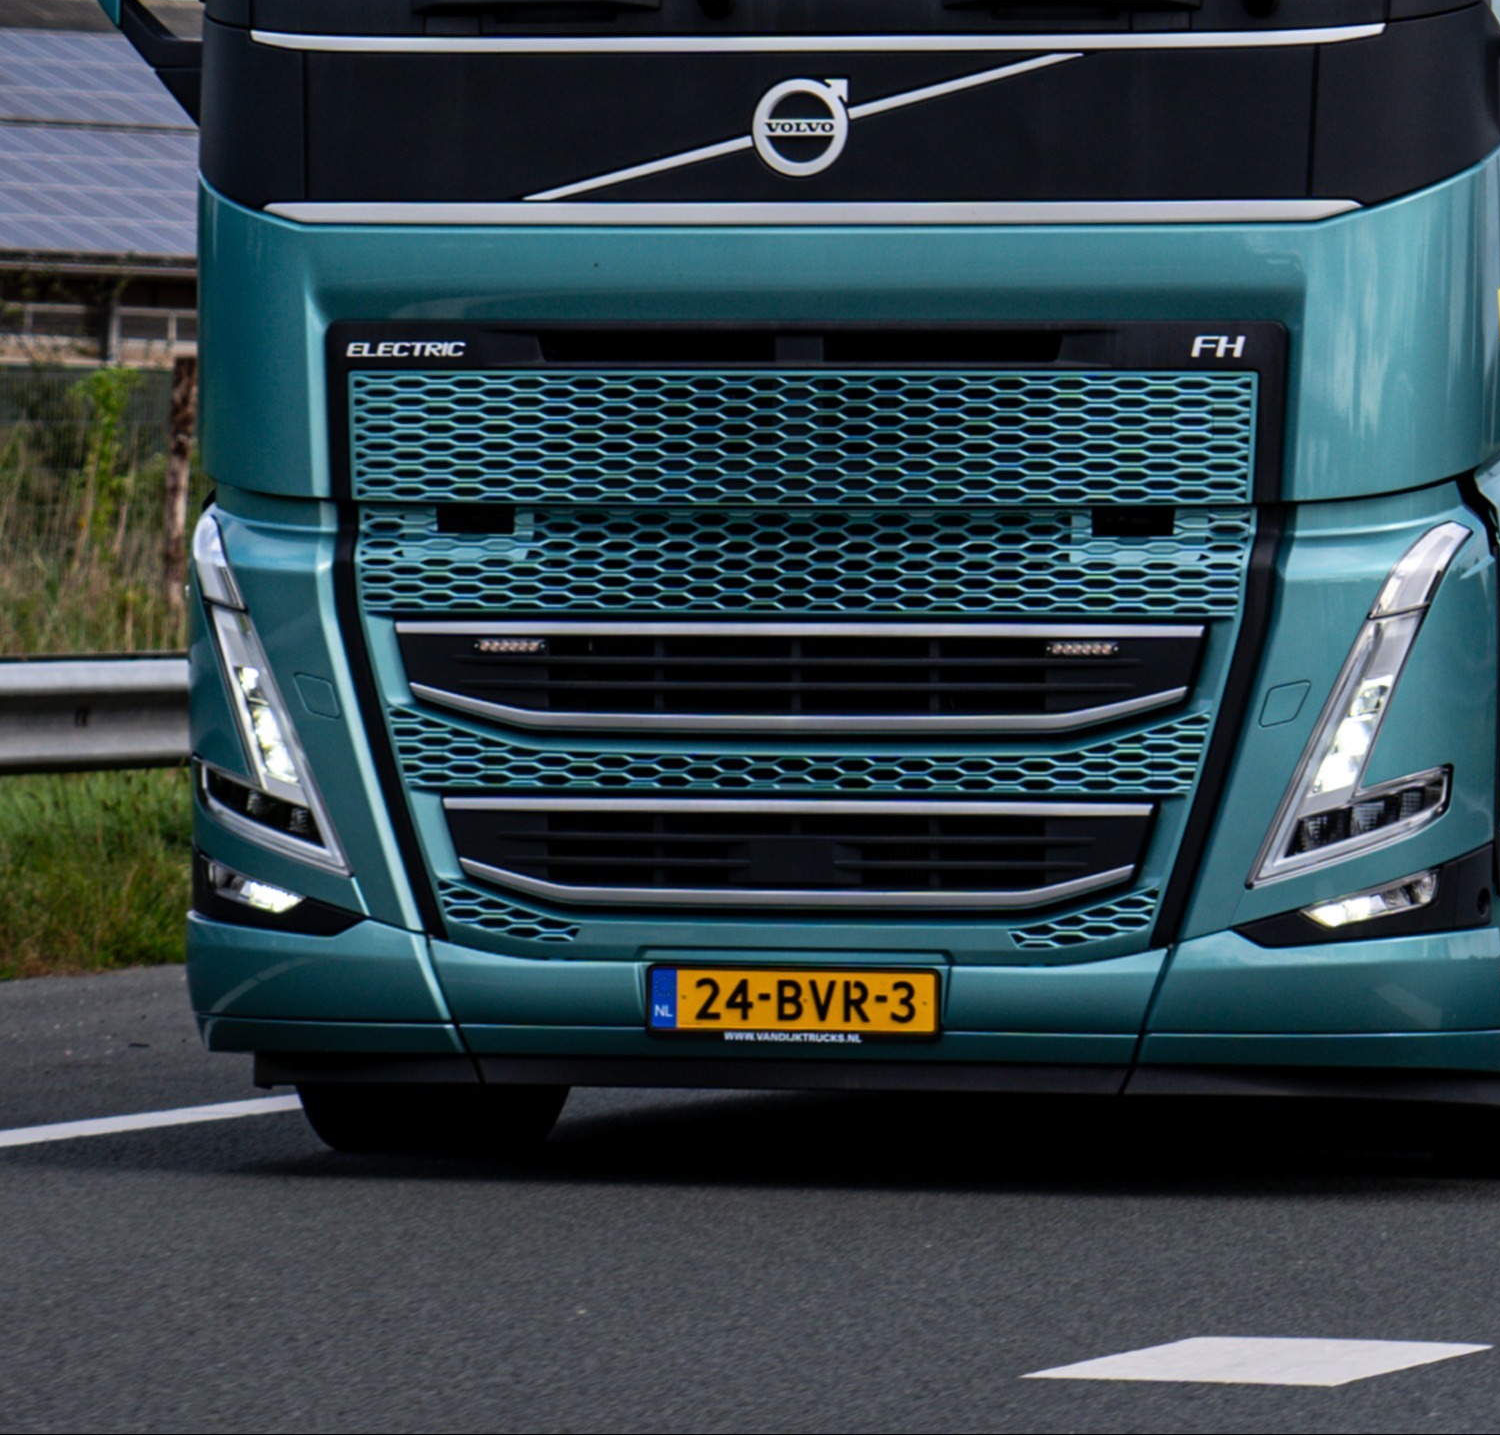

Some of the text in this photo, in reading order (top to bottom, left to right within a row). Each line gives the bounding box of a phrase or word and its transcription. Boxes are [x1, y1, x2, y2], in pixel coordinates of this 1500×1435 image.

[765, 122, 834, 133] VOLVO
[346, 341, 467, 358] ELECTRIC
[1190, 335, 1246, 358] FH
[695, 978, 916, 1023] 24-BVR-3
[654, 1004, 673, 1017] NL
[724, 1031, 862, 1043] WWW.VANDIJKTRUCKS.NL
